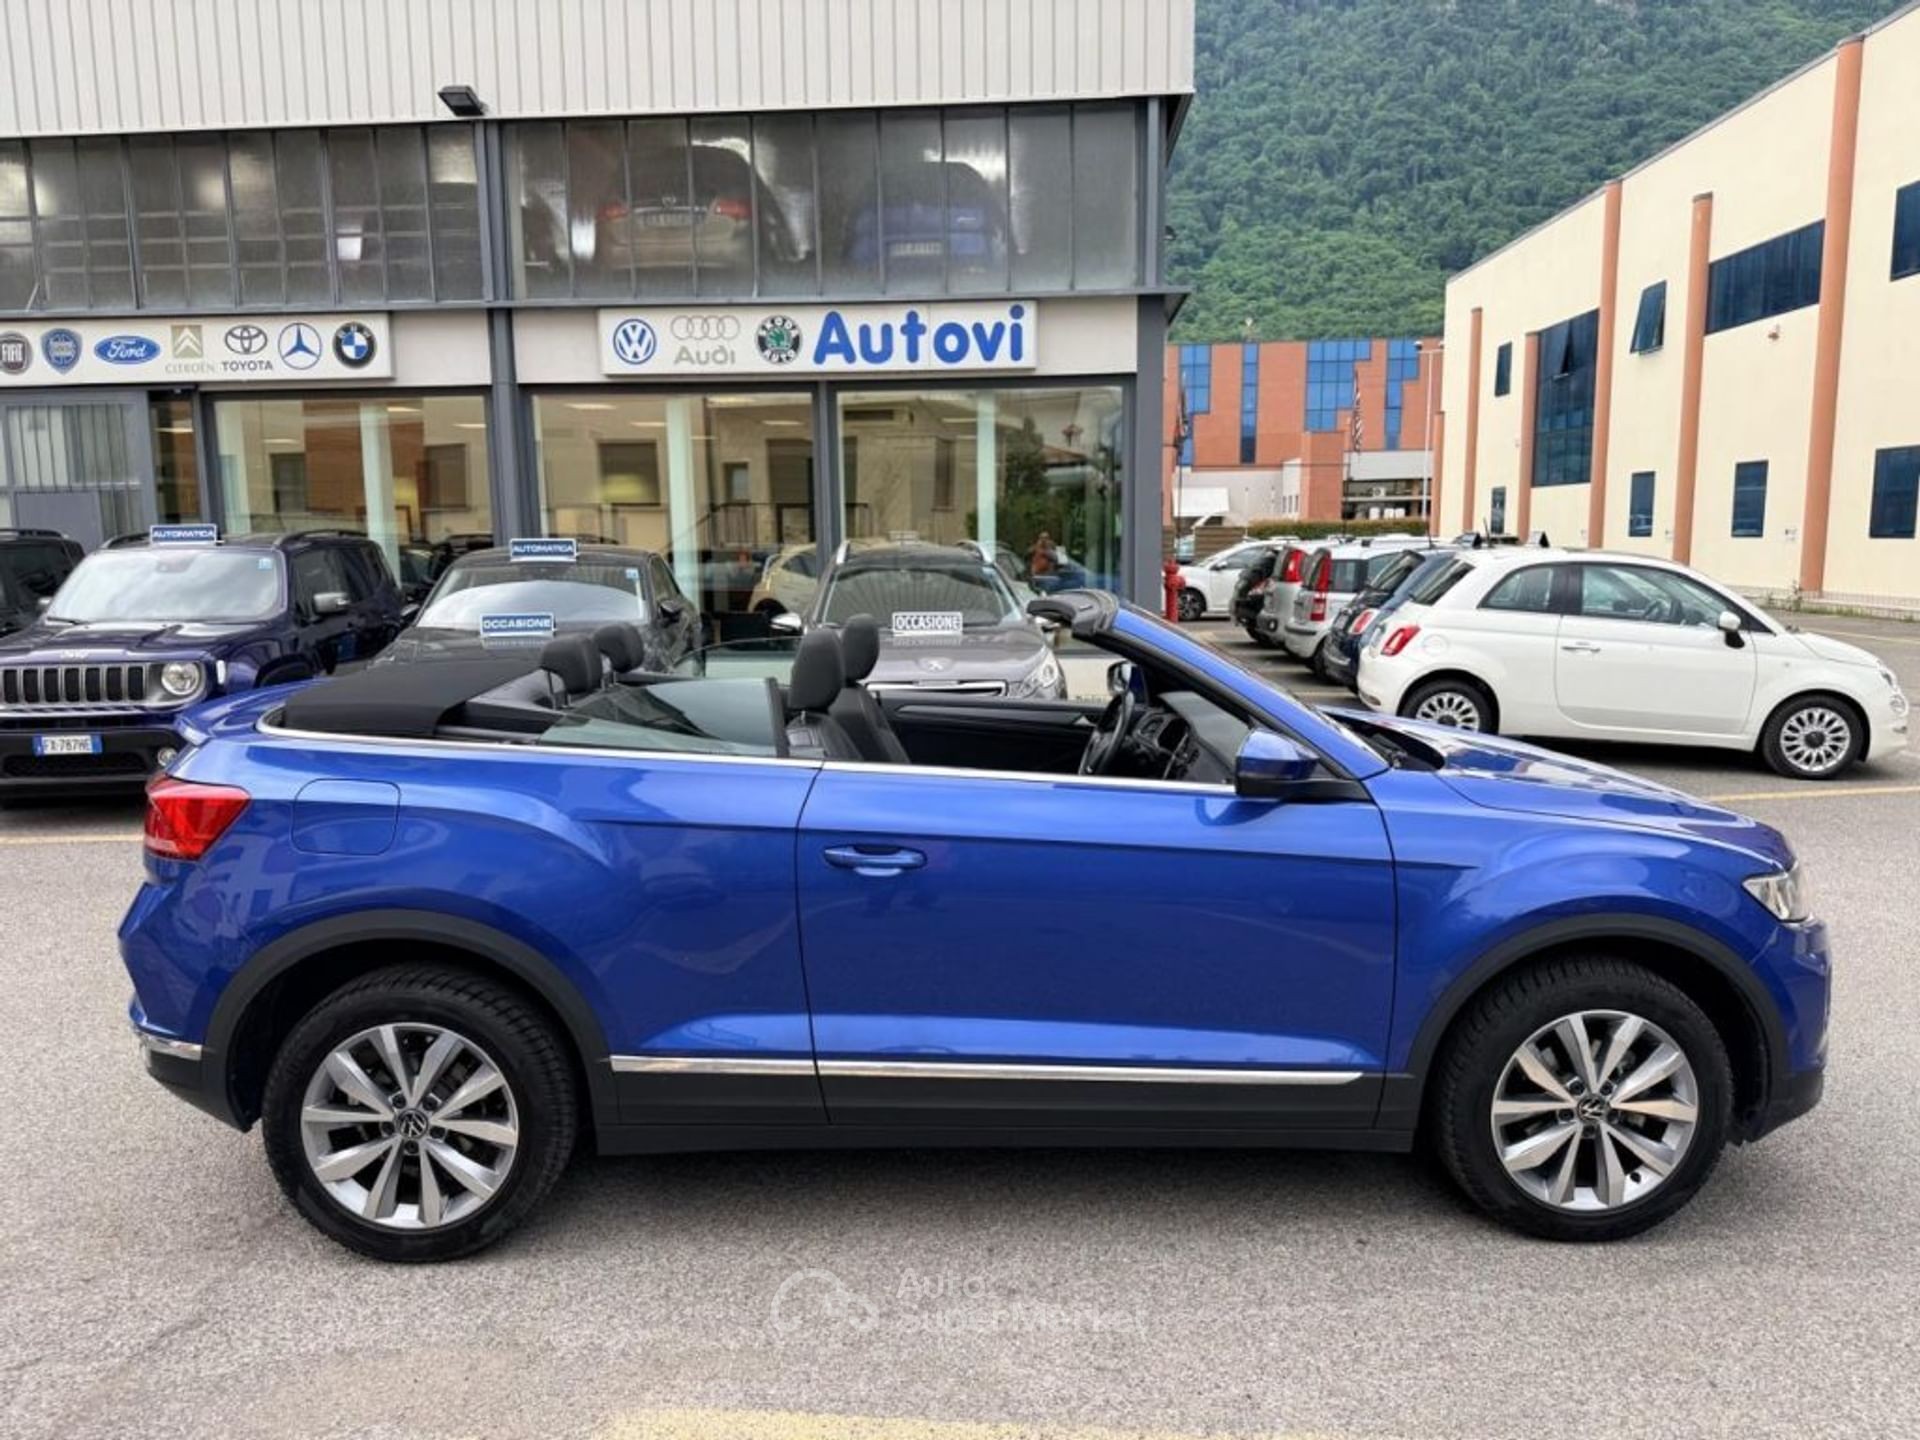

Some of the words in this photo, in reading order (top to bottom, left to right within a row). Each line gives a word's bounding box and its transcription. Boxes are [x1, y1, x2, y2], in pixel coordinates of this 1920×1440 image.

[813, 304, 1024, 365] Autovi
[107, 338, 147, 359] Ford
[673, 345, 736, 366] Audi
[222, 360, 273, 372] TOYOTA
[153, 530, 214, 539] AUTOMATICA
[513, 543, 573, 553] AUTOMATICA
[483, 618, 551, 629] OCCASIONE
[896, 616, 960, 629] OCCASIONE
